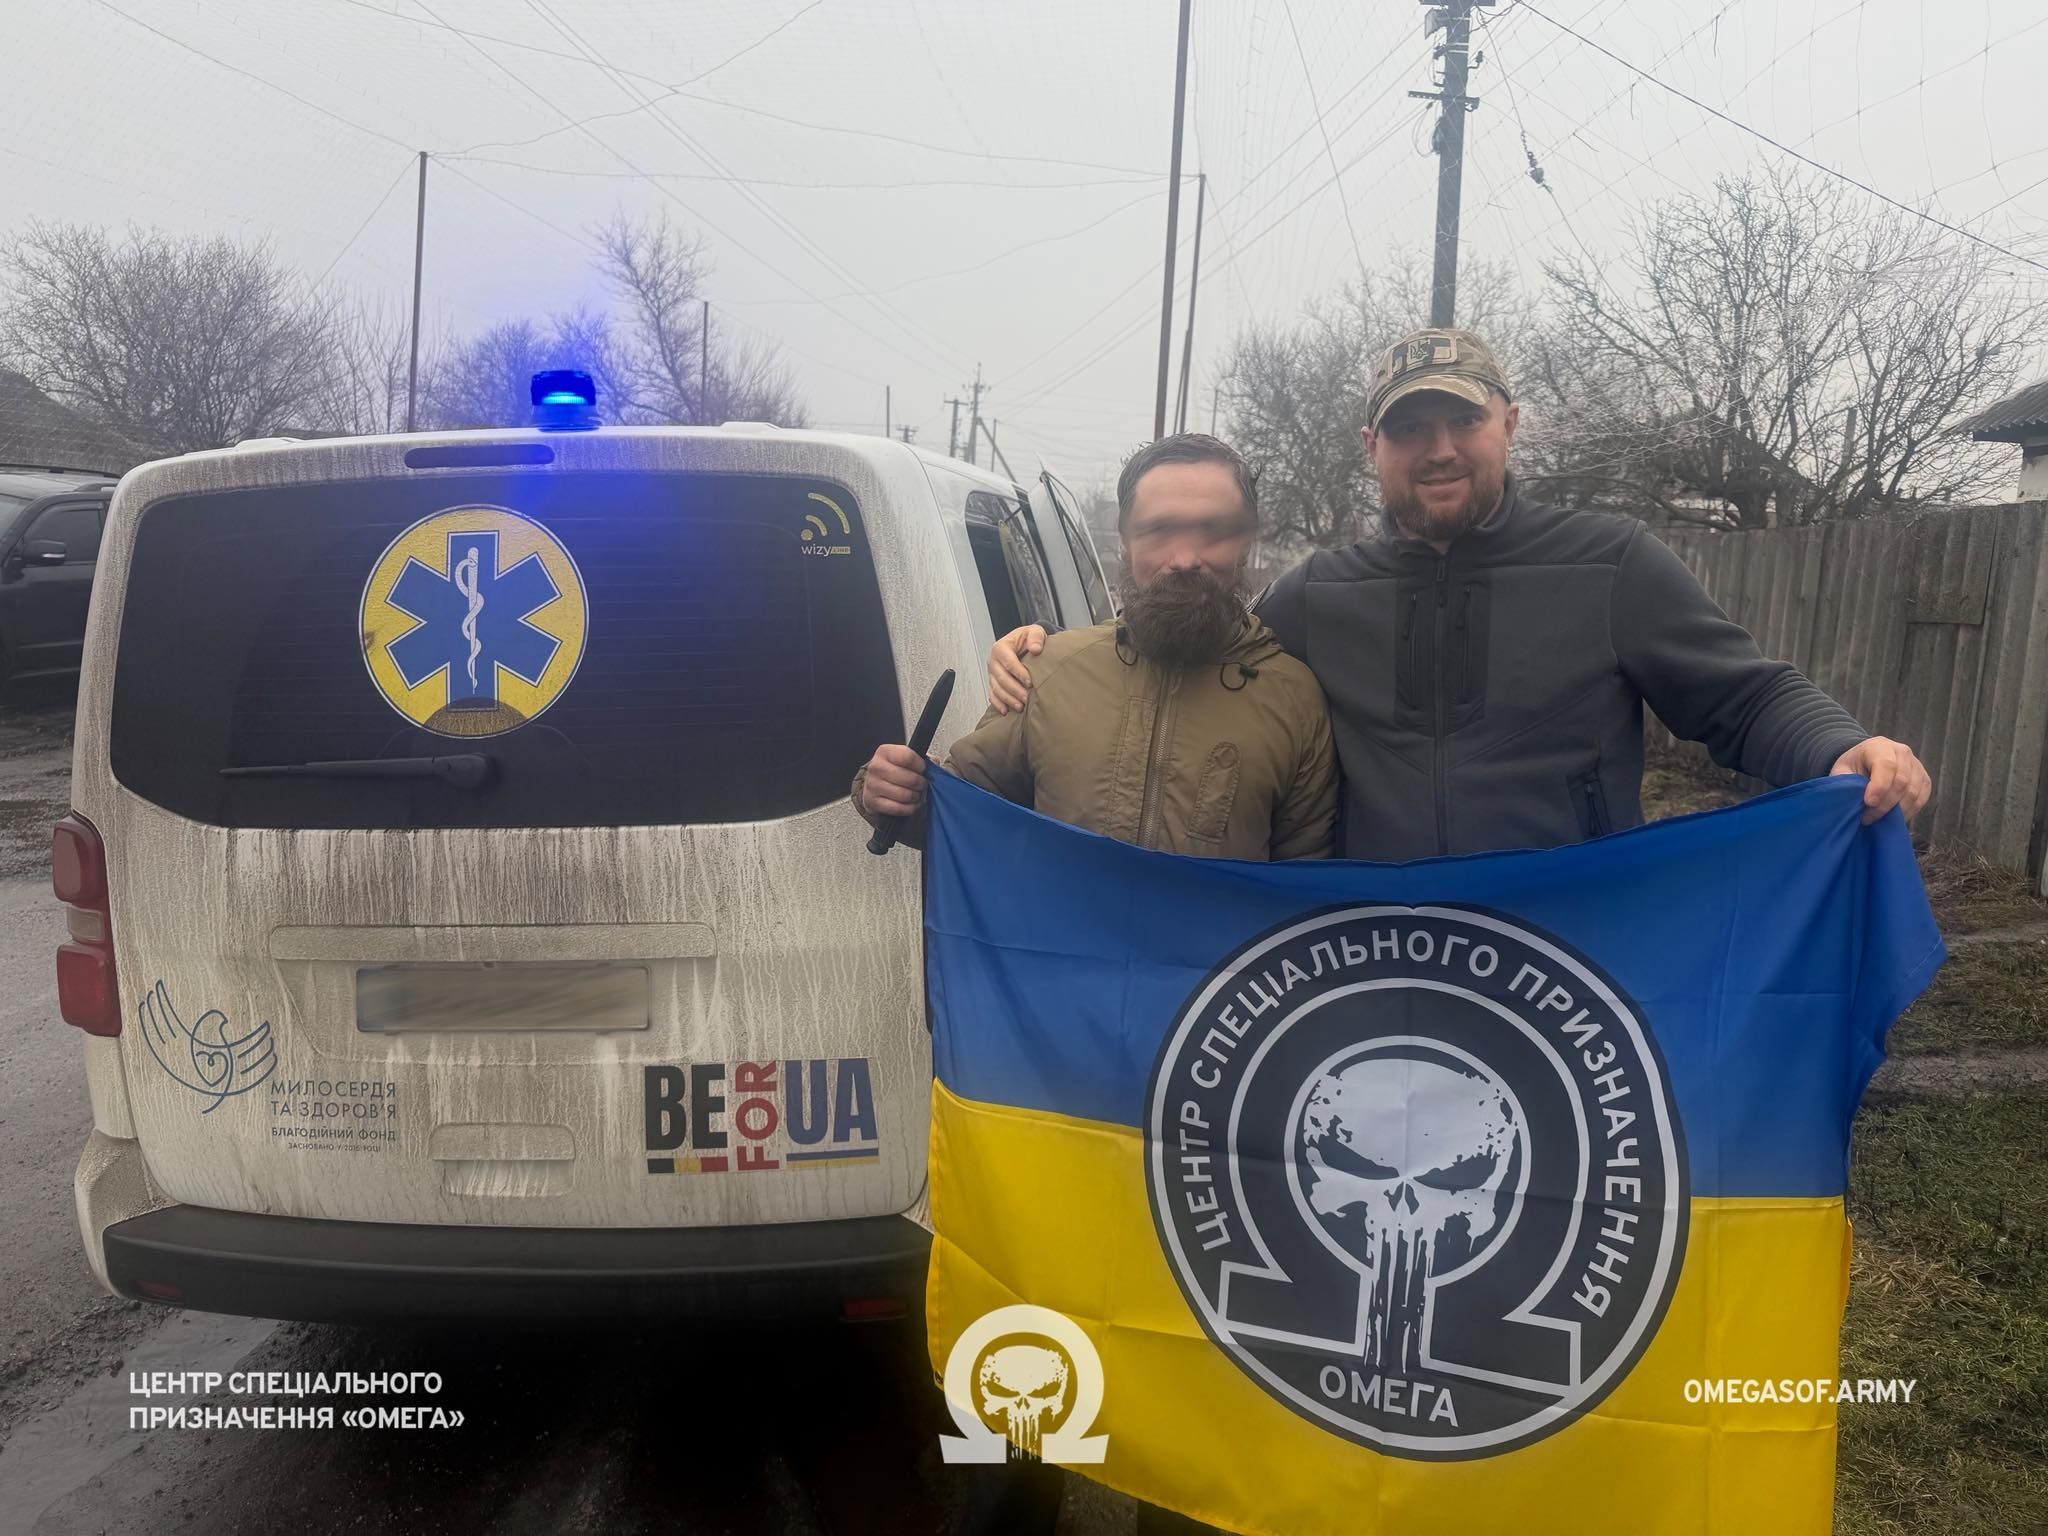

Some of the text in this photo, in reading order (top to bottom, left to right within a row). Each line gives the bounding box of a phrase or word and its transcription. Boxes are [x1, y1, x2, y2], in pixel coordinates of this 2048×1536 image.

[801, 543, 831, 557] wizy
[270, 1079, 396, 1100] МИЛОСЕРДЯ
[270, 1101, 396, 1120] ТА ЗДОРОВ'Я
[644, 1058, 878, 1171] BE FOR UA
[271, 1126, 396, 1142] БЛАГОДІЙНИЙ ФОНД
[1181, 928, 1642, 1320] ЦЕНТР СПЕЦІАЛЬНОГО ПРИЗНАЧЕННЯ
[1318, 1364, 1460, 1429] ОМЕГА
